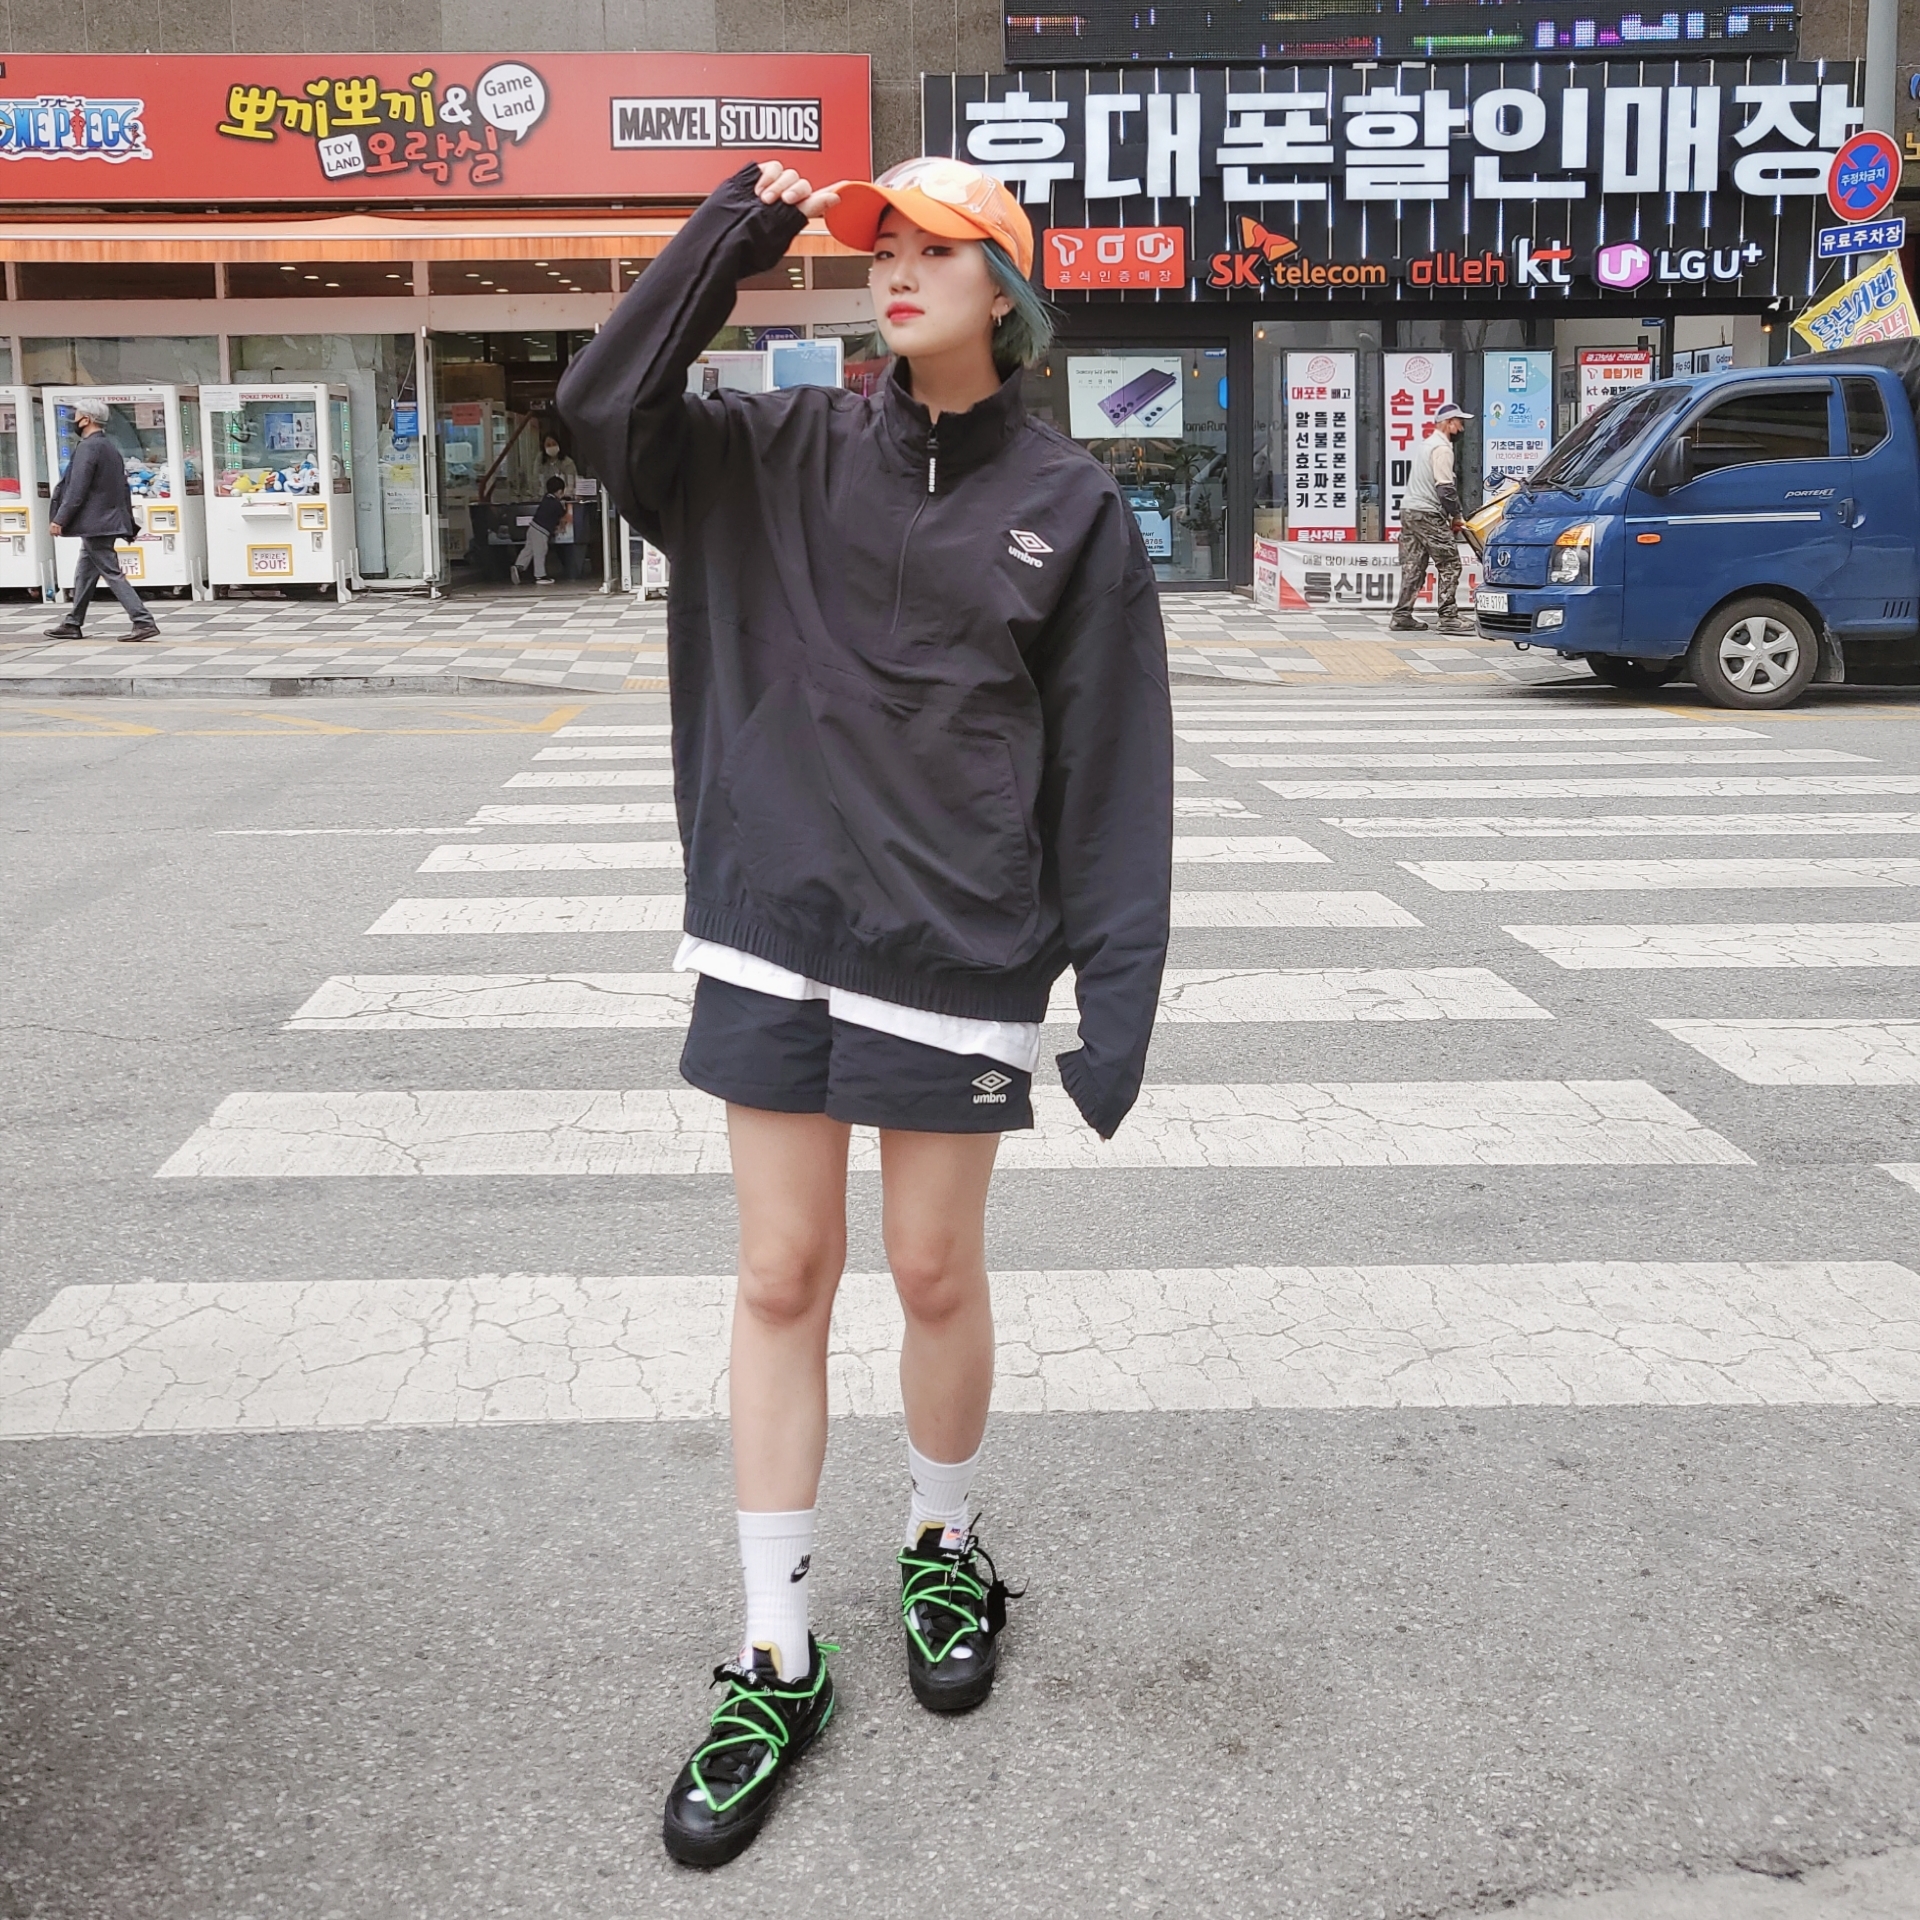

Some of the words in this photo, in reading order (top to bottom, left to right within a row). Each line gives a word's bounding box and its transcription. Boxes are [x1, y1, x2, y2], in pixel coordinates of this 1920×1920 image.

[484, 74, 534, 98] Game
[40, 98, 84, 108] ワンピース
[219, 72, 435, 140] 뽀끼뽀끼
[439, 87, 472, 125] &
[493, 96, 537, 120] Land
[54, 107, 141, 149] PIECE
[619, 107, 711, 141] MARVEL
[720, 105, 820, 142] STUDIOS
[324, 141, 354, 158] TOY
[365, 125, 500, 183] 오락실
[326, 156, 362, 173] LAND
[1840, 166, 1887, 188] 주정차금지
[1821, 223, 1902, 251] 유료주차장
[1411, 252, 1505, 284] olleh
[1518, 237, 1572, 284] kt
[1211, 253, 1261, 286] SK
[1274, 258, 1387, 285] telecom
[1292, 386, 1328, 400] 대포폰
[1586, 386, 1599, 396] kt
[1295, 411, 1347, 428] 알뜰폰
[1295, 452, 1347, 469] 효도폰
[1295, 473, 1347, 489] 공짜폰
[1295, 493, 1347, 509] 키즈폰
[1783, 489, 1826, 499] PORTER
[257, 560, 283, 570] OUT
[1008, 545, 1044, 569] umbro
[1348, 556, 1369, 567] 사용
[1303, 571, 1394, 603] 통신비
[972, 1092, 1007, 1104] umbro
